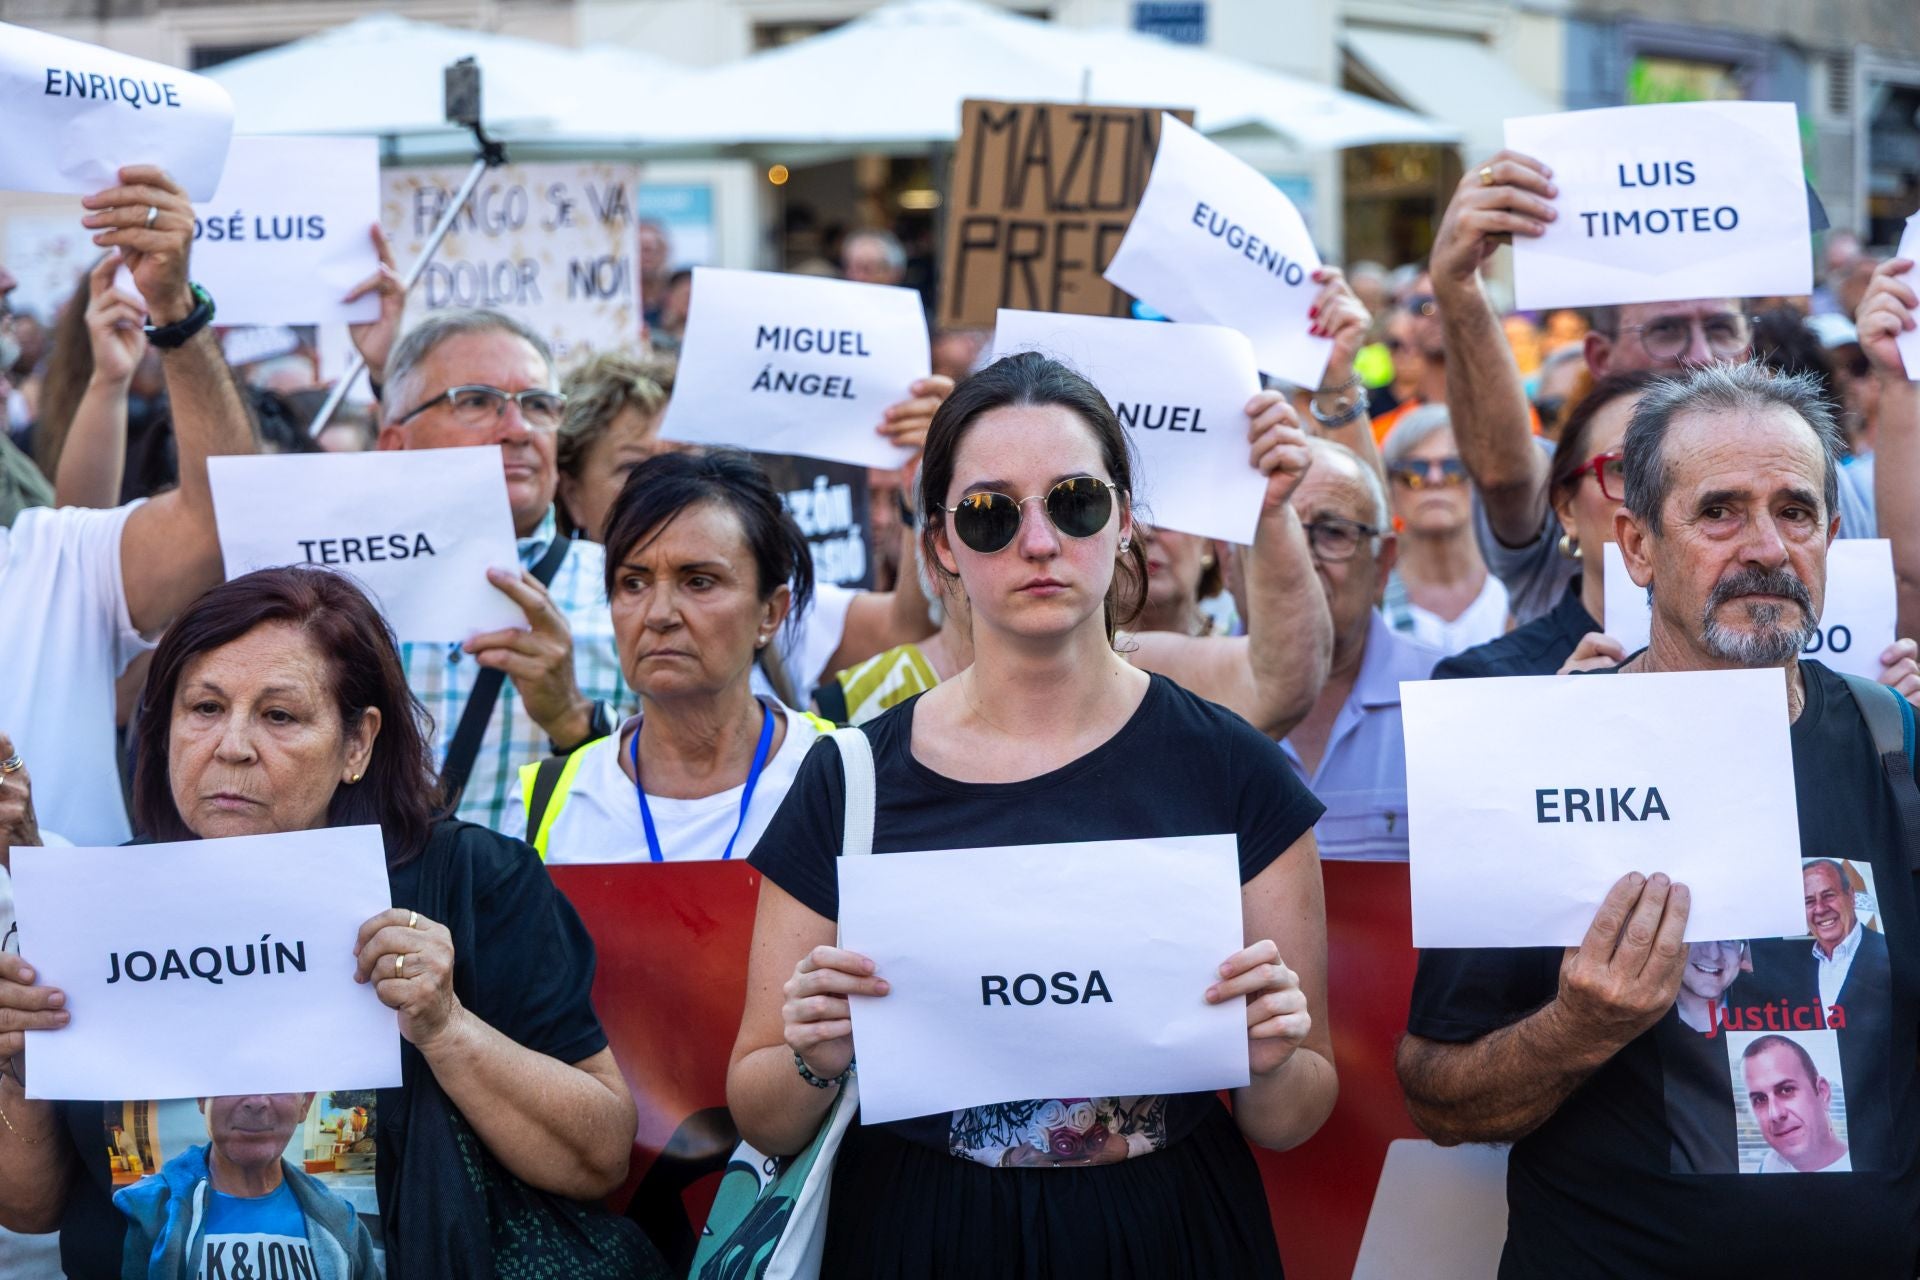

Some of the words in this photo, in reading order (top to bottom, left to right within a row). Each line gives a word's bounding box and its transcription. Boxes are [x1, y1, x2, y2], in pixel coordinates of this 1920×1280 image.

[44, 68, 182, 109] ENRIQUE
[1619, 161, 1696, 187] LUIS
[583, 181, 632, 225] VA
[256, 215, 326, 240] LUIS
[1580, 206, 1740, 238] TIMOTEO
[1192, 201, 1303, 287] EUGENIO
[426, 257, 543, 310] DOLOR
[756, 326, 870, 356] MIGUEL
[752, 364, 856, 399] ÁNGEL
[1117, 402, 1207, 433] NUEL
[298, 532, 436, 564] TERESA
[1536, 787, 1671, 824] ERIKA
[107, 933, 307, 985] JOAQUÍN
[981, 970, 1114, 1006] ROSA
[1705, 998, 1847, 1038] Justicia
